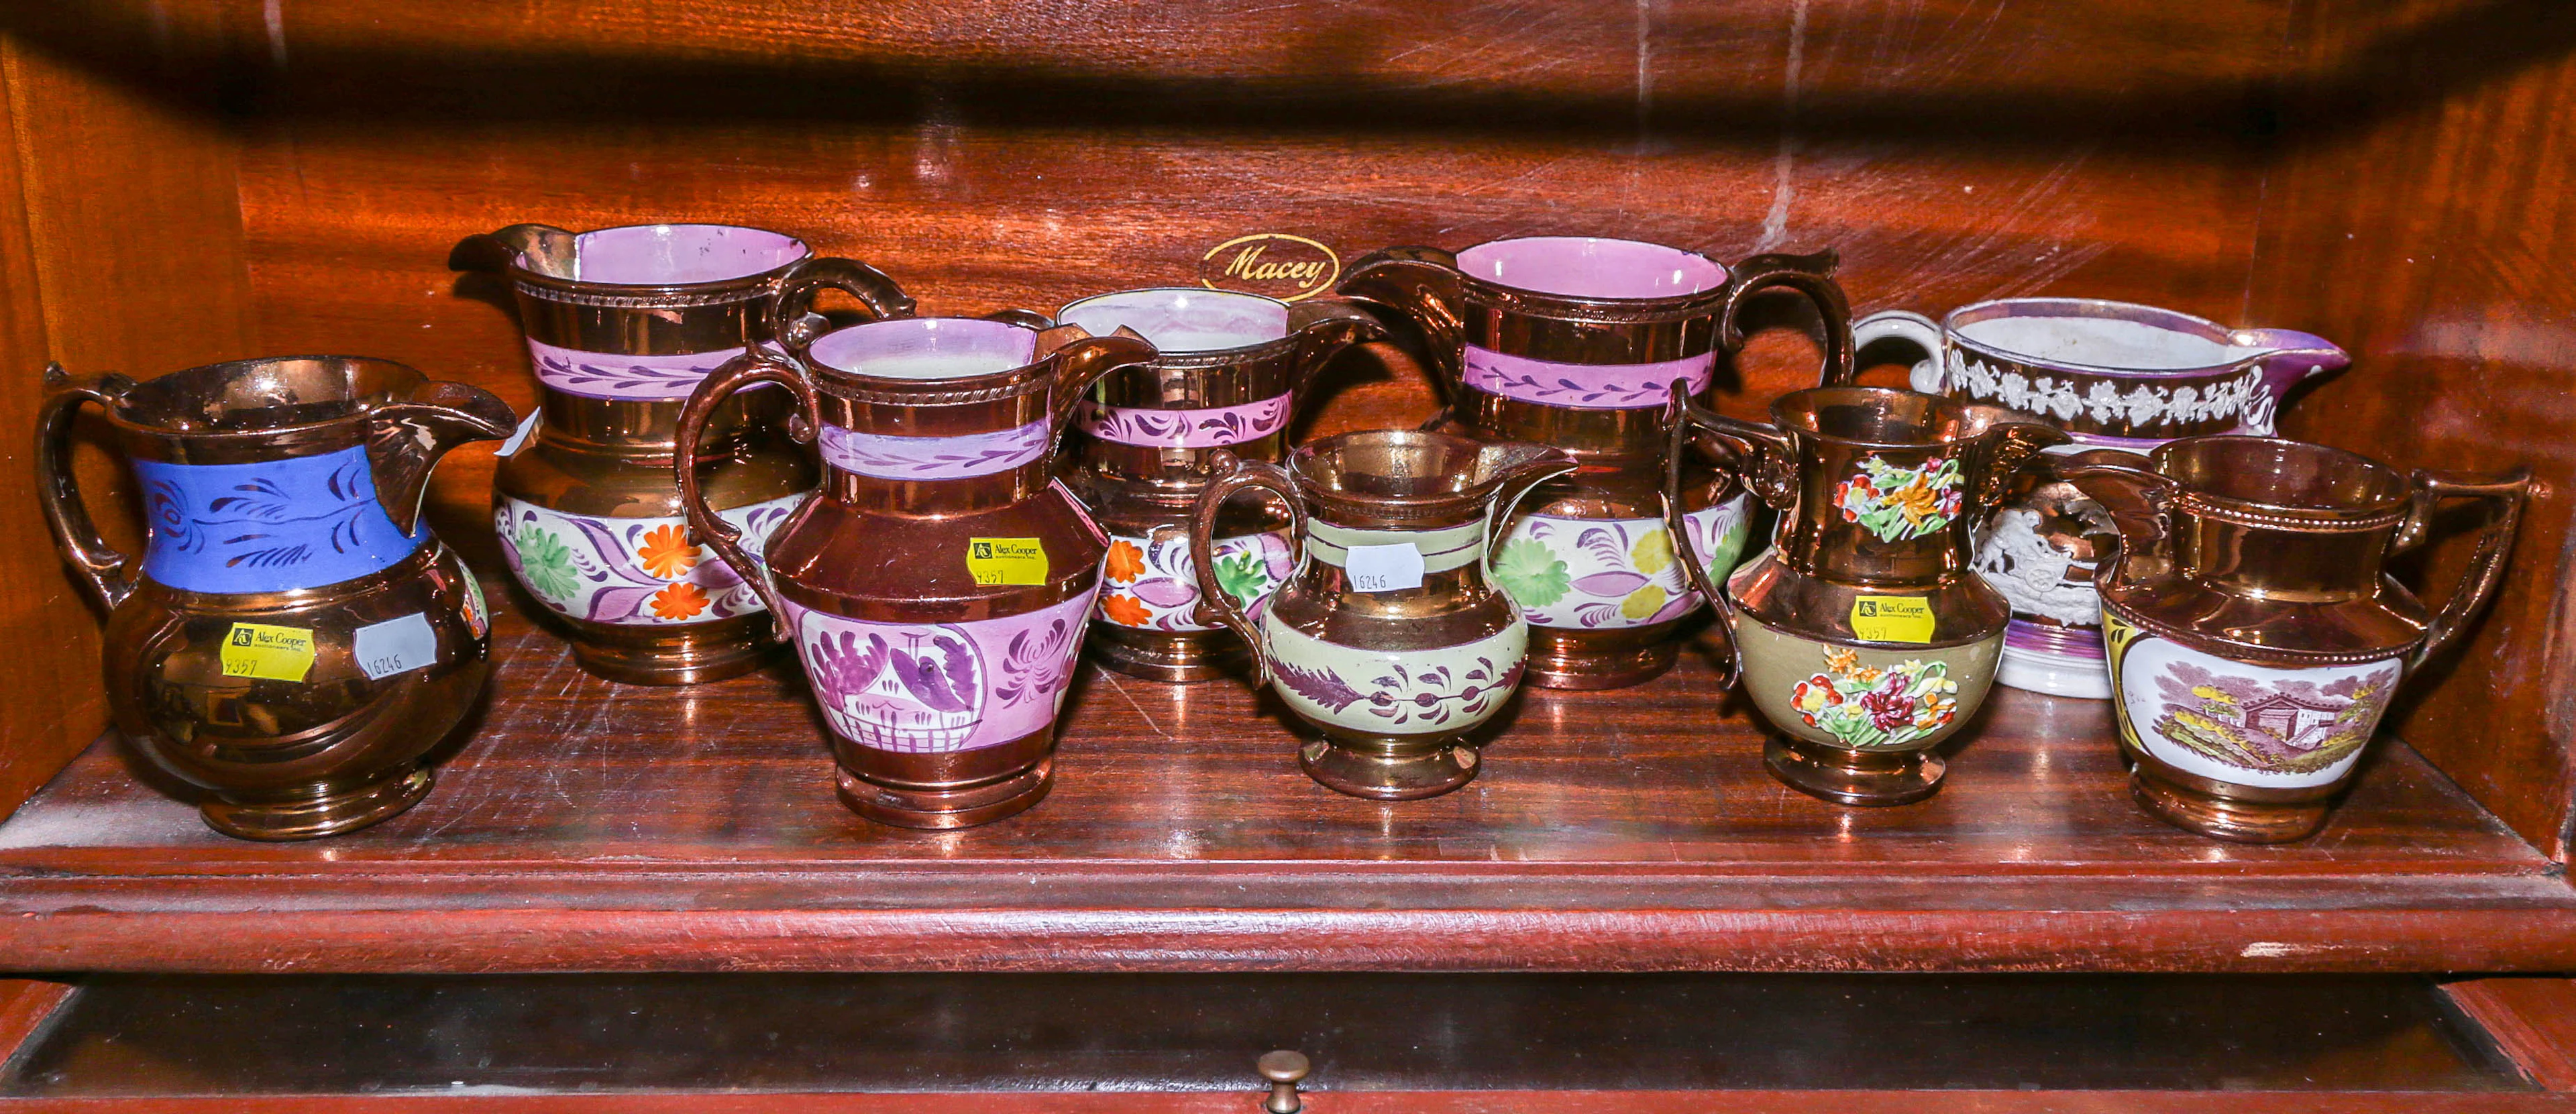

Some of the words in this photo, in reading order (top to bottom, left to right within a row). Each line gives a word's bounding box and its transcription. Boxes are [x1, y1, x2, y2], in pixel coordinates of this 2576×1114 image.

[1225, 245, 1326, 288] Macey
[995, 544, 1010, 555] Alex
[1011, 544, 1037, 557] Cooper
[977, 570, 1004, 583] 9357
[1354, 575, 1386, 589] 16246
[1880, 603, 1896, 613] Alex
[1897, 603, 1925, 616] Cooper
[256, 632, 274, 643] Alex
[275, 632, 306, 647] Cooper
[225, 659, 258, 676] 9357
[367, 654, 402, 676] 16246
